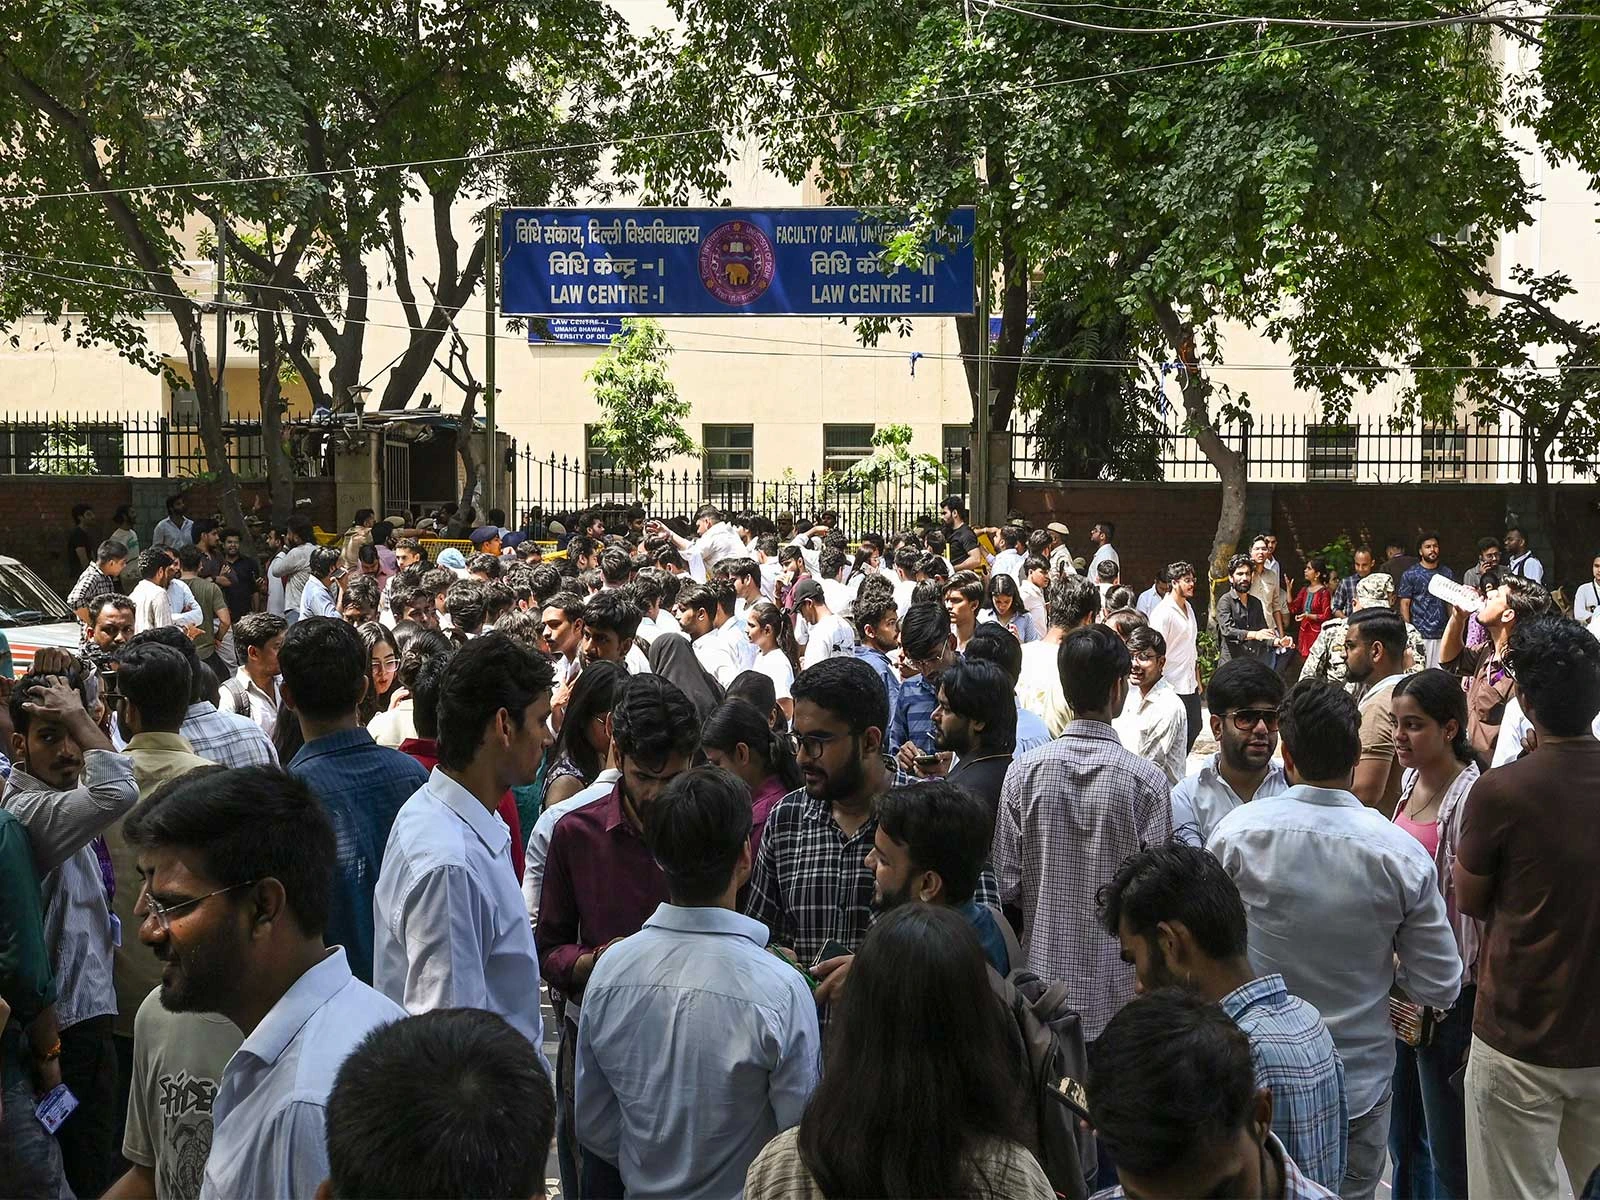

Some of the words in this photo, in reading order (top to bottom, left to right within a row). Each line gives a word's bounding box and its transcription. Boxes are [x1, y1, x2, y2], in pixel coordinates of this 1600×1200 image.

[515, 218, 542, 244] विधि
[543, 219, 585, 249] संकाय,
[587, 218, 622, 245] दिल्ली
[625, 218, 700, 245] विश्वविद्यालय
[776, 225, 818, 244] FACULTY
[820, 225, 833, 243] OF
[835, 225, 858, 247] LAW,
[548, 251, 590, 275] विधि
[593, 252, 637, 279] केन्द्र
[810, 250, 852, 275] विधि
[550, 285, 584, 304] LAW
[587, 285, 648, 304] CENTRE
[811, 284, 845, 304] LAW
[849, 284, 911, 304] CENTRE
[915, 284, 935, 304] -II
